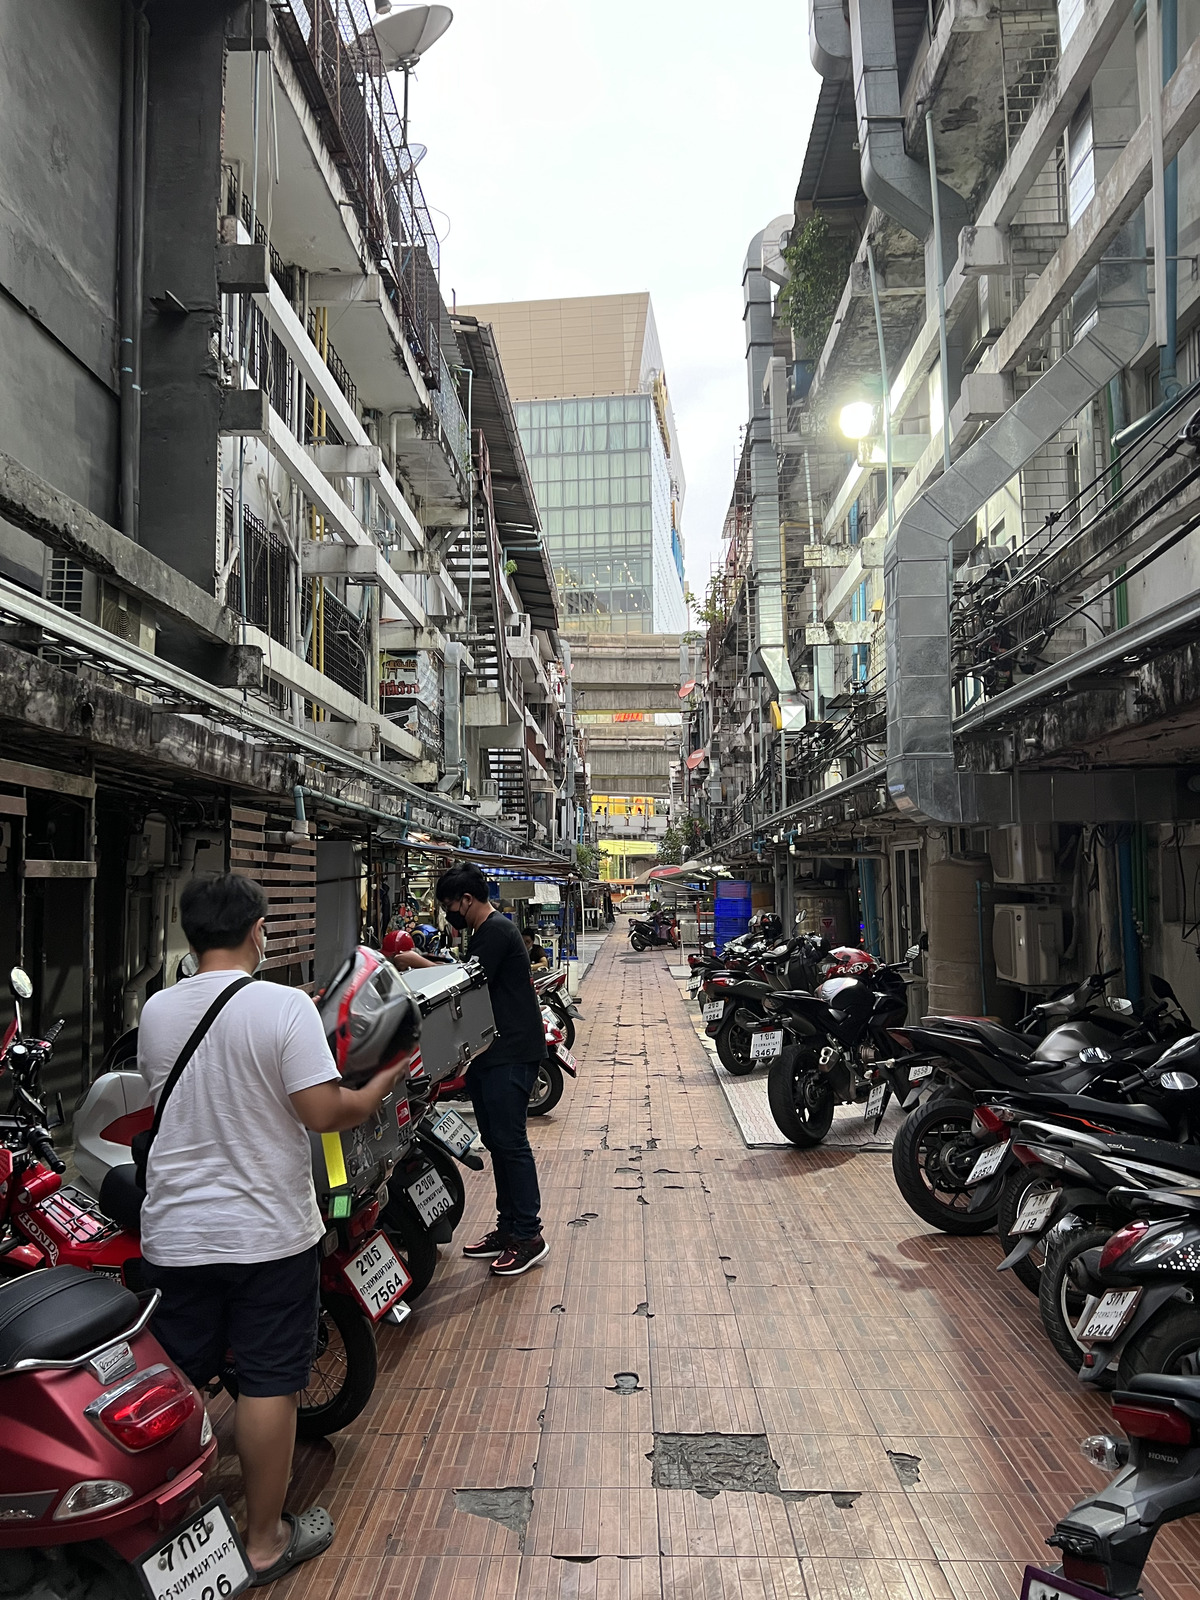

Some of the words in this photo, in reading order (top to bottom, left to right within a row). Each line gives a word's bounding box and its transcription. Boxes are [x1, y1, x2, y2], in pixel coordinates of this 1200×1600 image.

[755, 1048, 776, 1057] 3467
[456, 1133, 471, 1150] 210
[427, 1197, 450, 1221] 1030
[1020, 1217, 1037, 1230] 119
[359, 1256, 398, 1296] กรุงเทพมหานคร
[370, 1272, 404, 1310] 7564
[1148, 1452, 1179, 1464] HONDA
